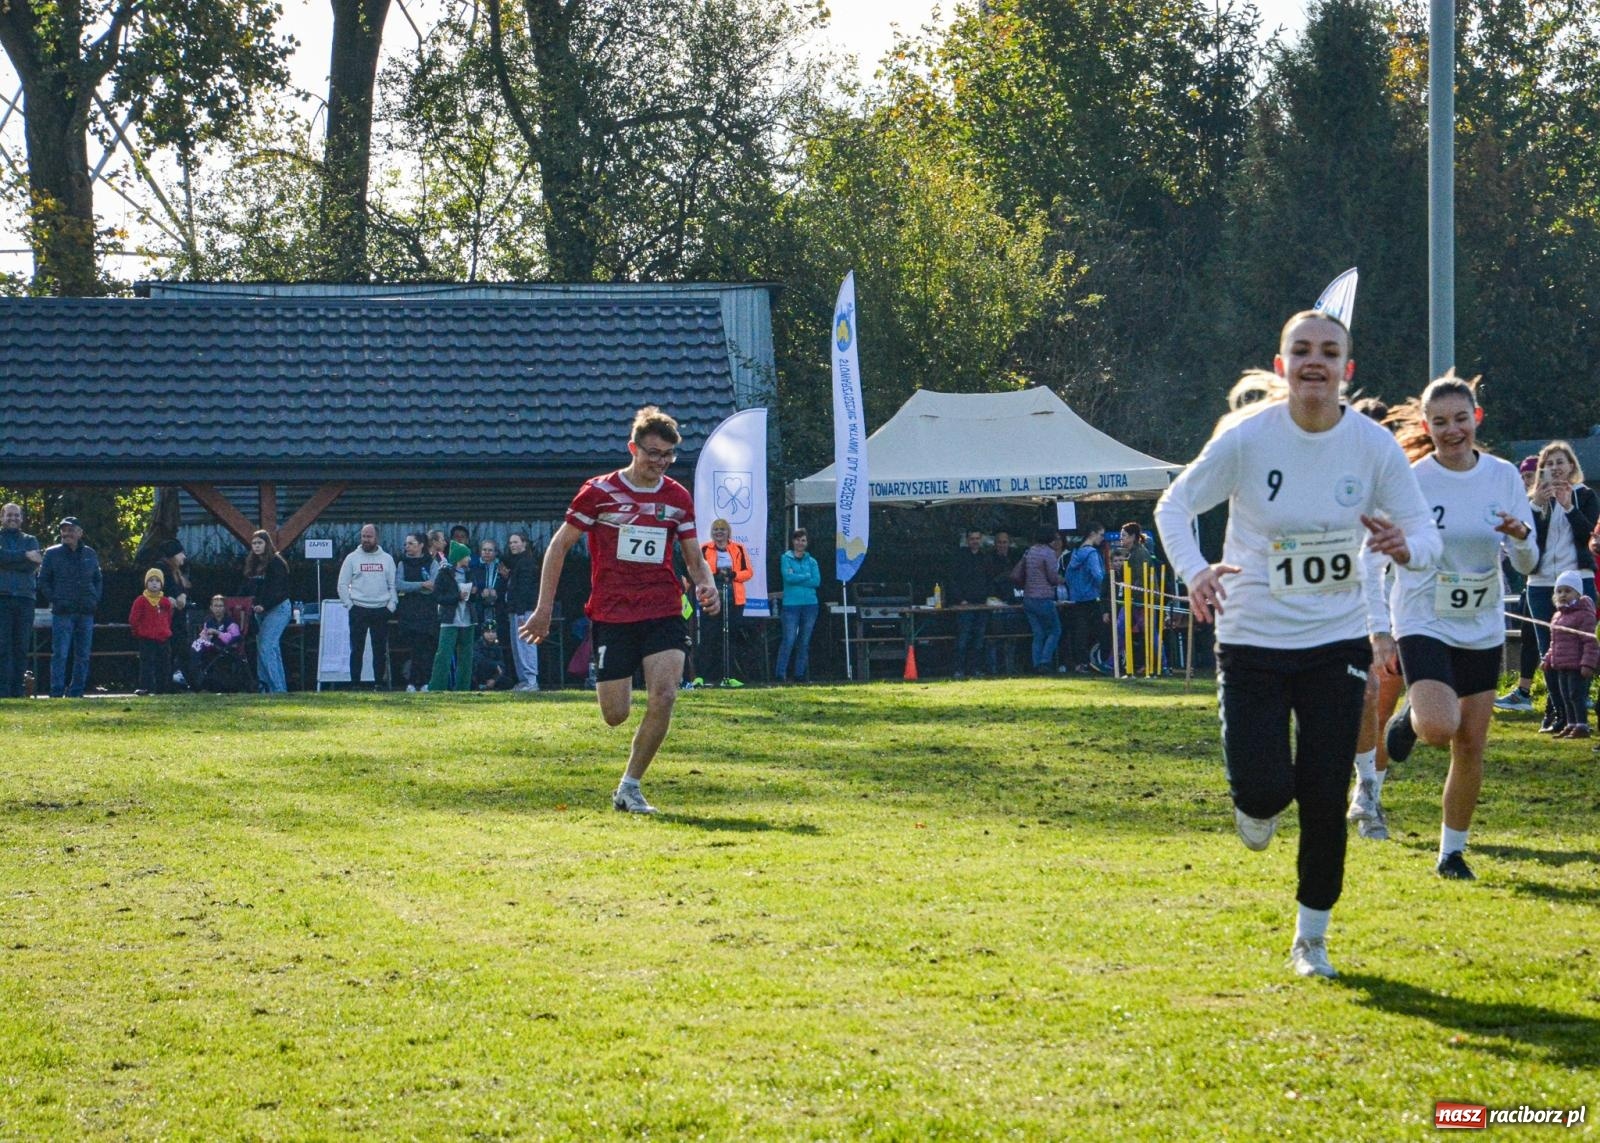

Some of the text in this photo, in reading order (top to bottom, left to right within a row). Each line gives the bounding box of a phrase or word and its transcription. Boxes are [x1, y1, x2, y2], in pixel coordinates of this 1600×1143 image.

[868, 473, 1128, 497] TOWARZYSZENIE AKTYWNI DLA LEPSZEGO JUTRA
[1267, 469, 1283, 502] 9
[1433, 505, 1446, 530] 2
[629, 538, 656, 557] 76
[1276, 553, 1352, 586] 109
[1450, 587, 1488, 609] 97
